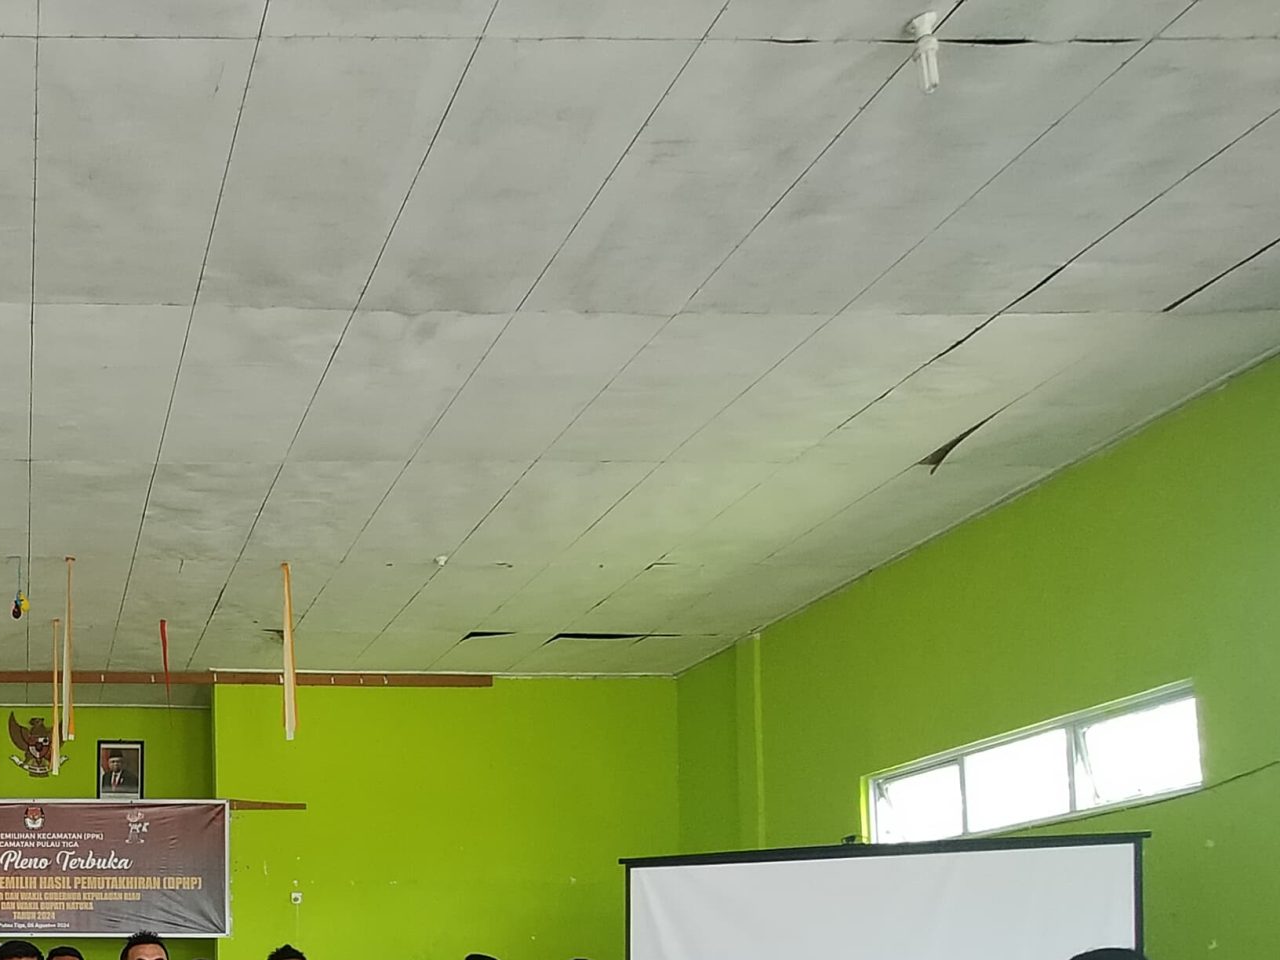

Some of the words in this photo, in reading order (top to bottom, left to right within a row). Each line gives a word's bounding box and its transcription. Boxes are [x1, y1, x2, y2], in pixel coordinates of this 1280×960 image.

[0, 850, 52, 871] Pleno
[56, 850, 133, 871] Terbuka
[39, 876, 71, 889] HASIL
[73, 876, 160, 890] PEMUTAKHIRAN
[20, 892, 43, 900] WAKIL
[16, 901, 39, 910] WAKIL
[39, 901, 65, 910] BUPATI
[12, 911, 36, 920] TAHUN
[37, 911, 56, 920] 2024
